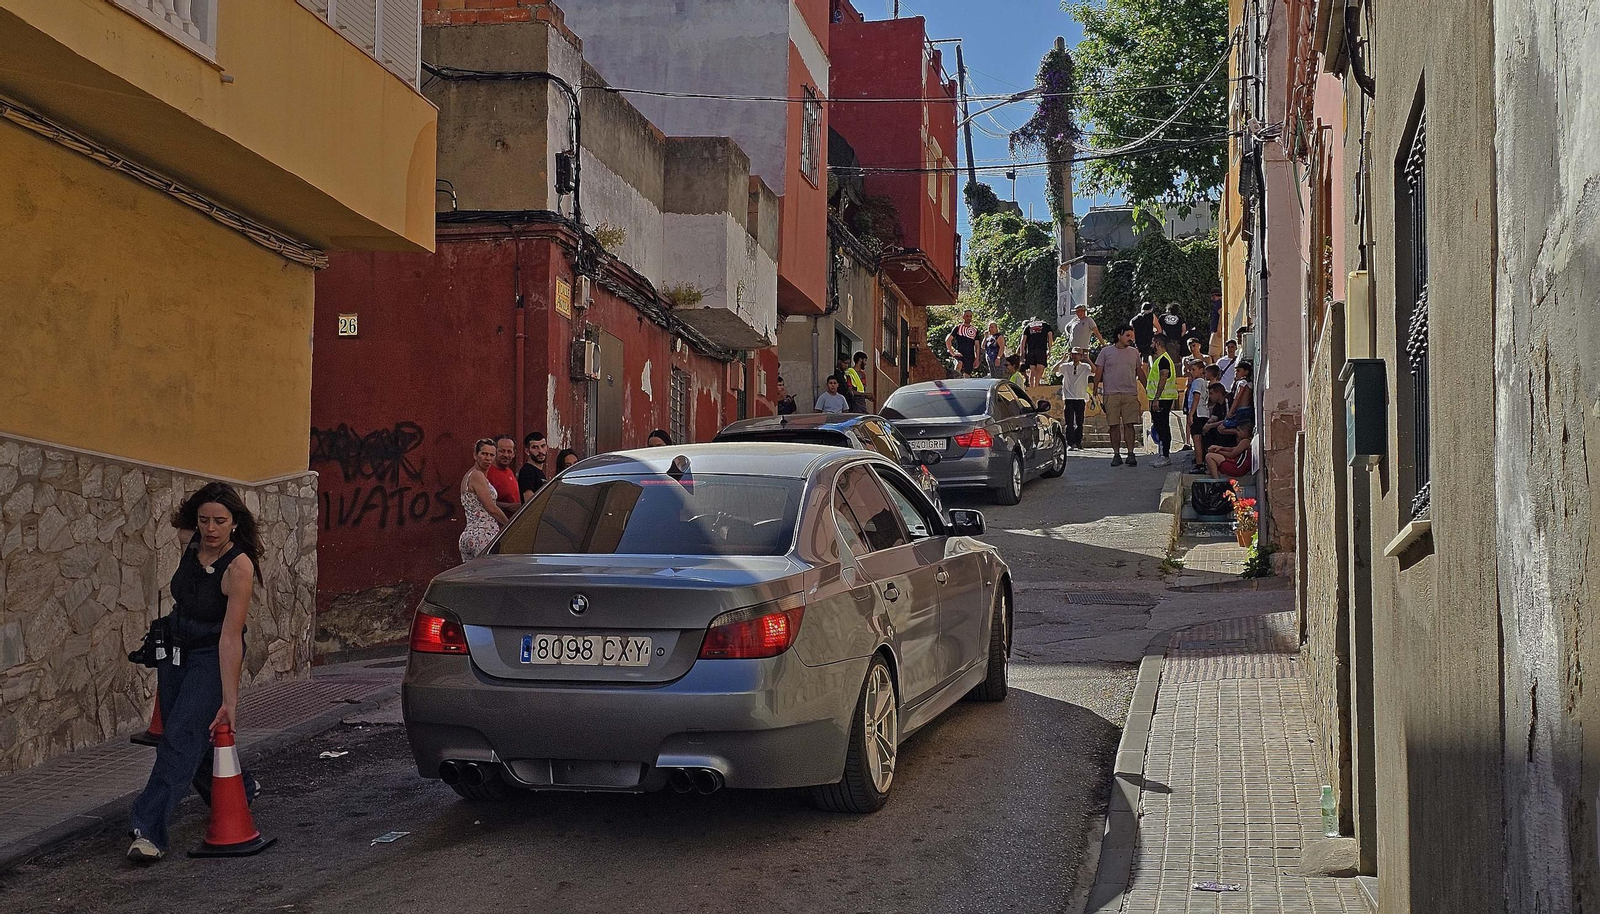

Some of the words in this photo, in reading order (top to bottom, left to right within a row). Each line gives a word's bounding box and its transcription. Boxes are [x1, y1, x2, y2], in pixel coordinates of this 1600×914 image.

[340, 318, 356, 334] 26
[928, 440, 944, 449] GRH
[537, 638, 593, 661] 8098
[603, 639, 646, 662] CXY
